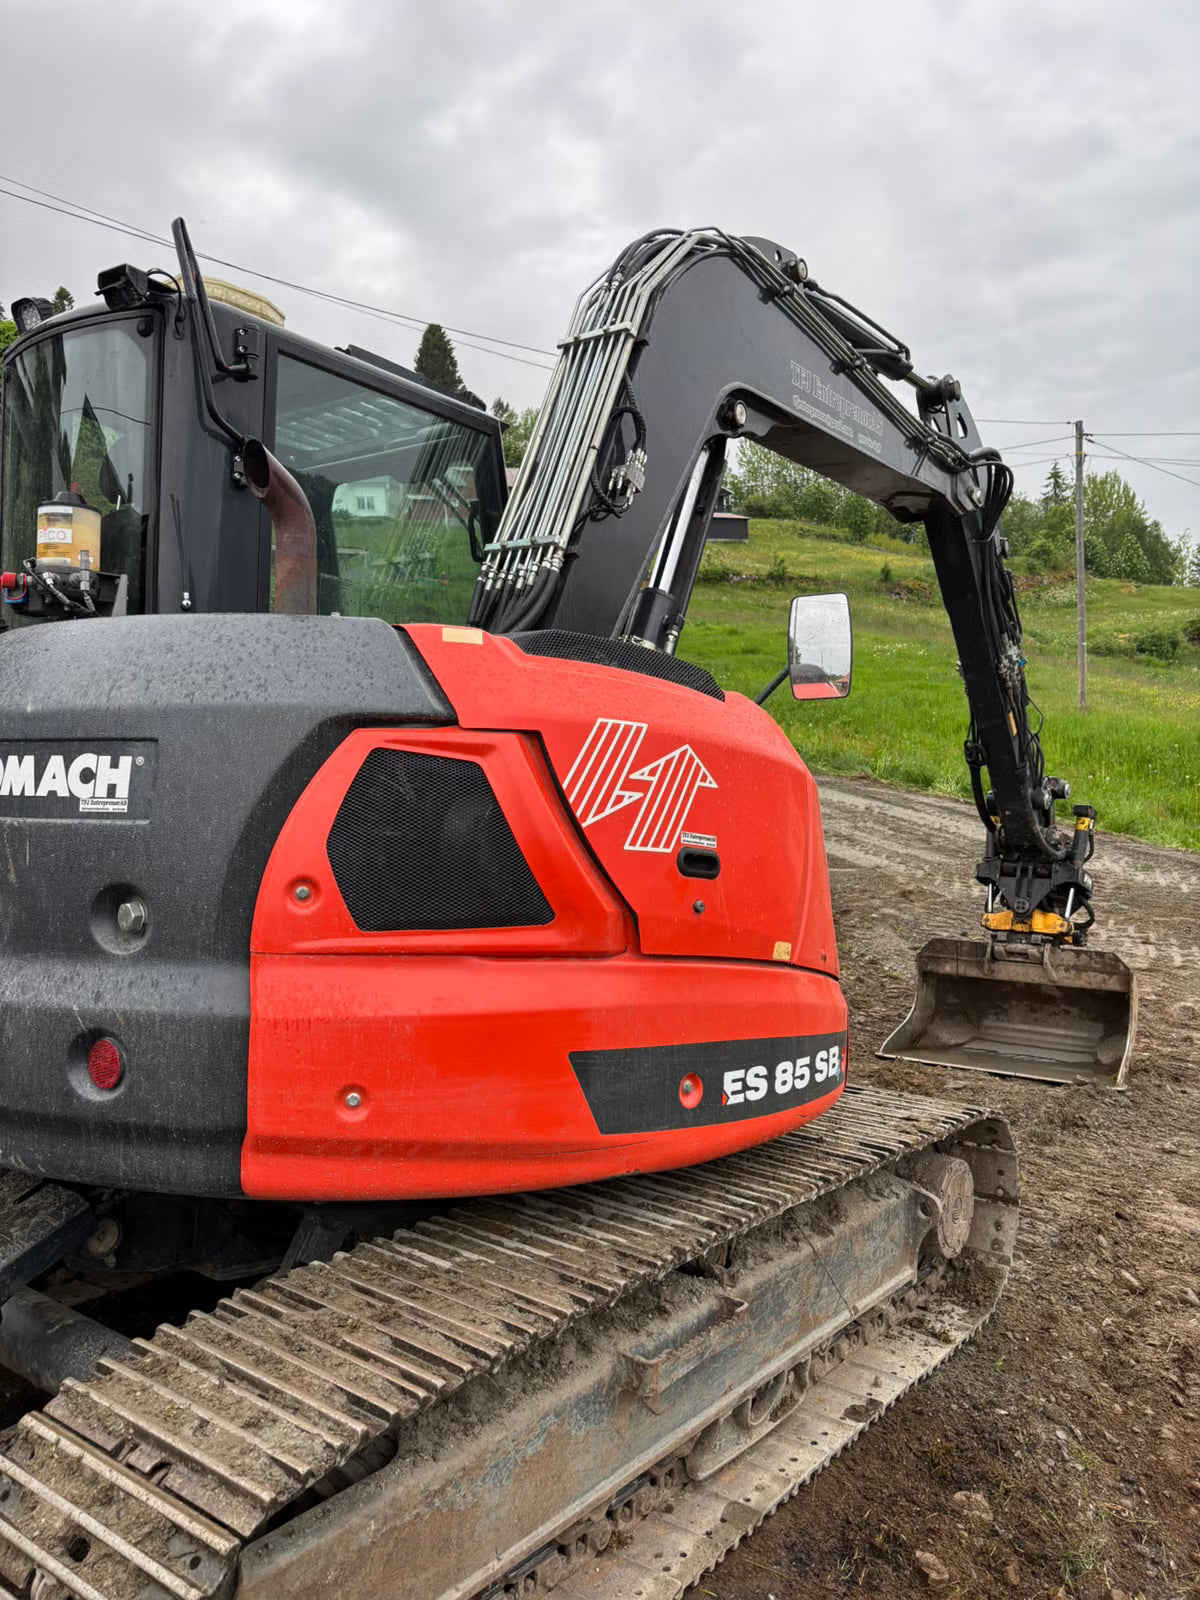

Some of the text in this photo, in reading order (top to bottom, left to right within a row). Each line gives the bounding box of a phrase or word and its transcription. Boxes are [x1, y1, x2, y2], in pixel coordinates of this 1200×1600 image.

[0, 752, 133, 799] MACH
[723, 1045, 839, 1106] ES 85 SB
